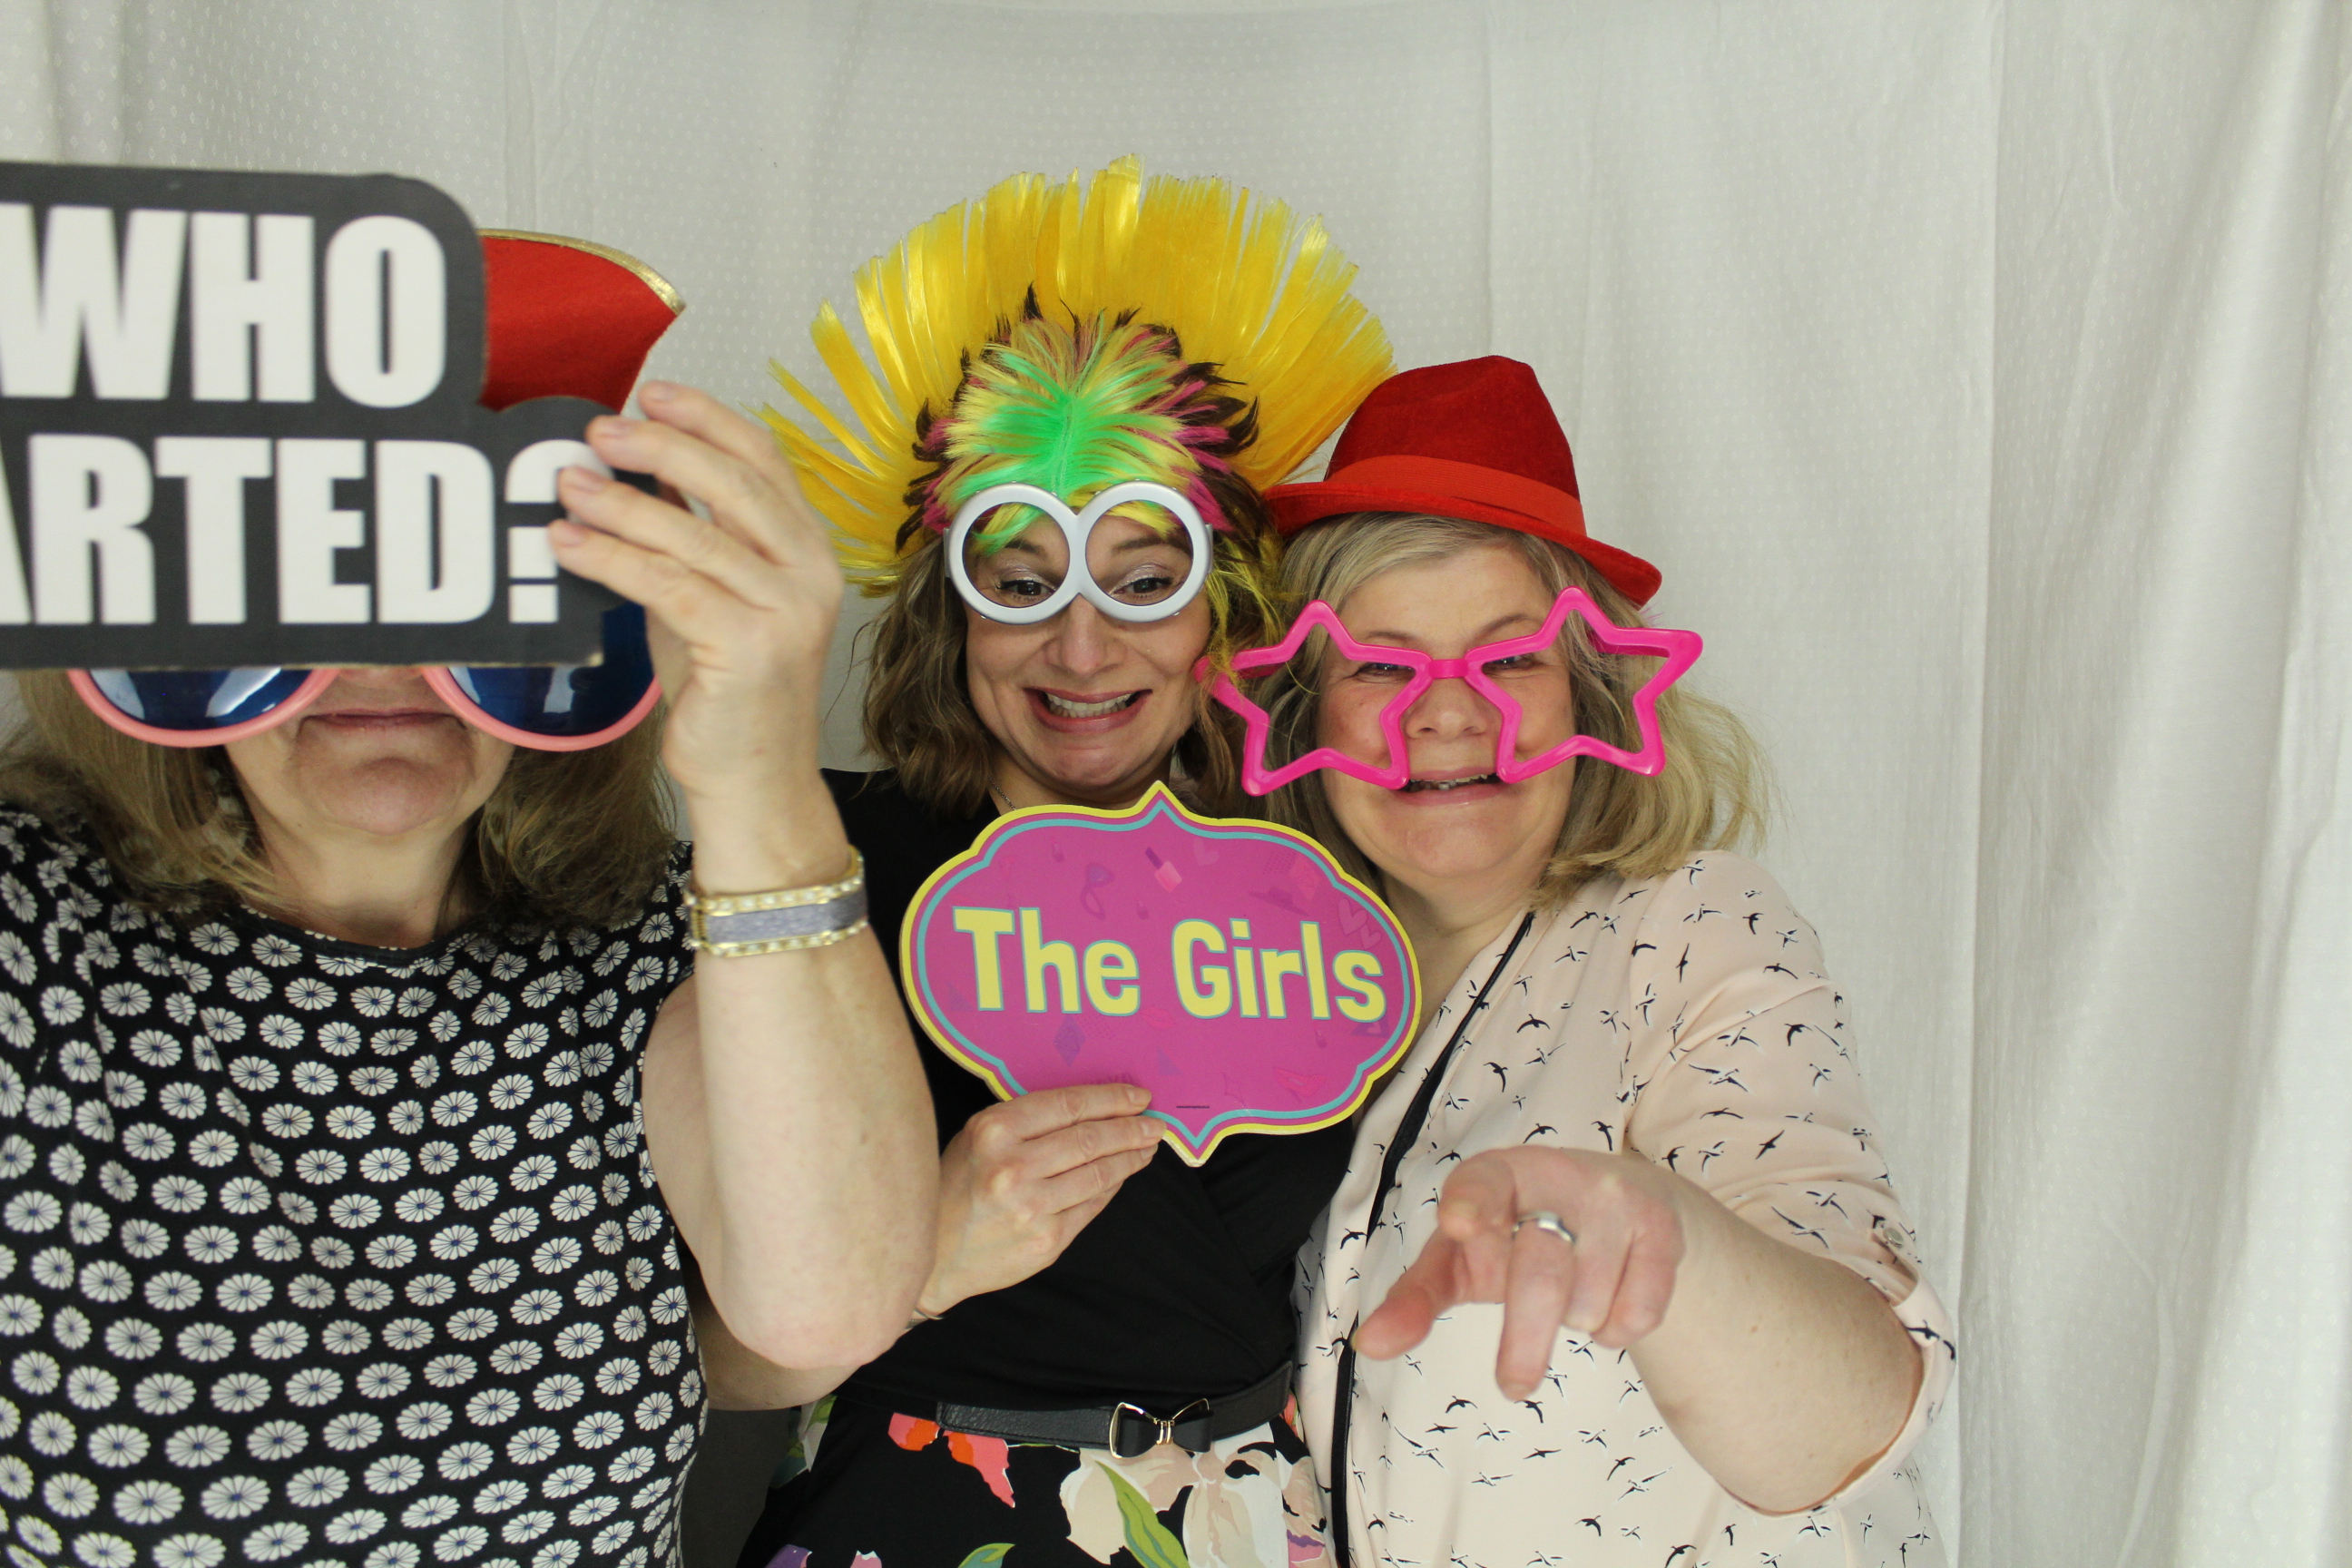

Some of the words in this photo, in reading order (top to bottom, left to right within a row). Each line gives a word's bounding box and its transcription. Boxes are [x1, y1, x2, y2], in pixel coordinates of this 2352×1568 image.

[0, 202, 446, 408] WHO
[0, 433, 615, 624] RTED?
[953, 906, 1141, 1017] The
[1171, 918, 1387, 1023] Girls
